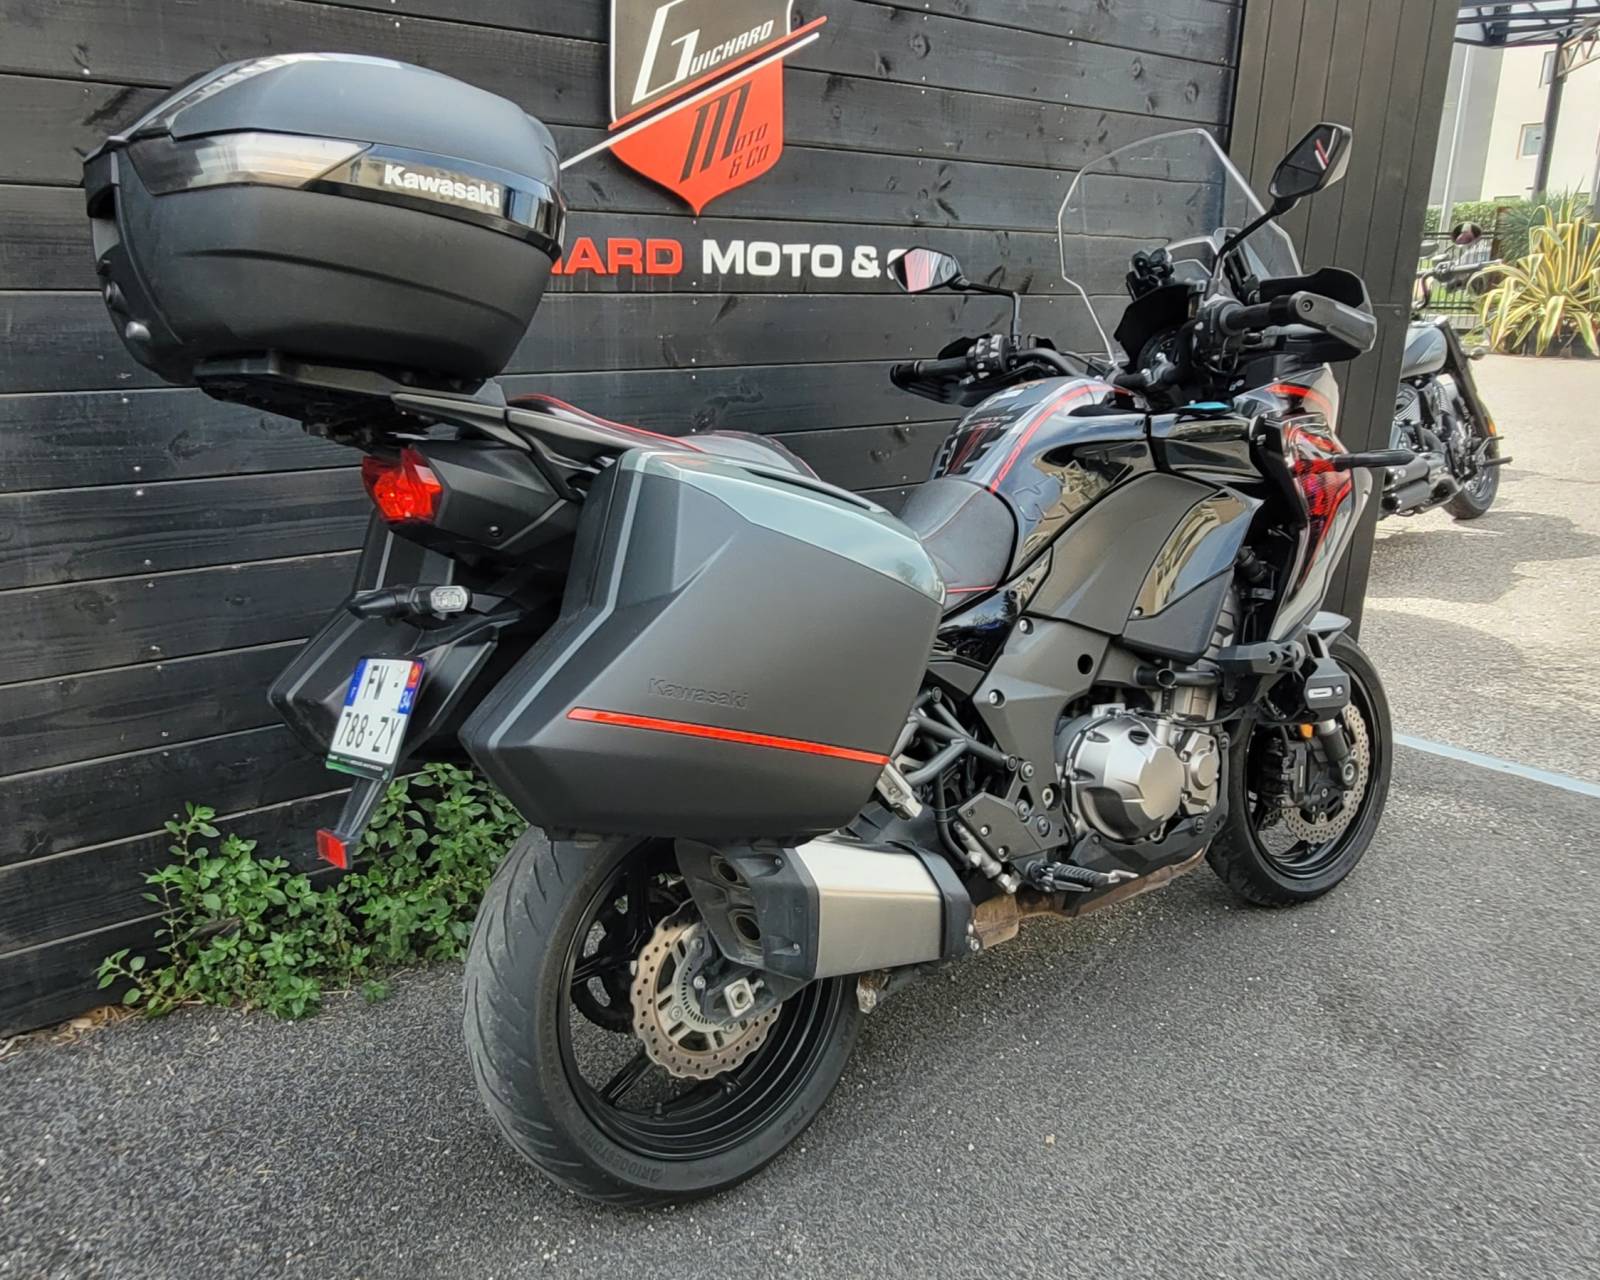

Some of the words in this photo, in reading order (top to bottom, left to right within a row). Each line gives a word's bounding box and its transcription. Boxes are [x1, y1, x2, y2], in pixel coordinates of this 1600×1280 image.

[632, 0, 774, 105] GUICHARD
[384, 164, 499, 208] Kawasaki
[551, 237, 682, 275] ARD
[648, 678, 749, 710] Kawasaki
[338, 712, 400, 754] 788-ZY
